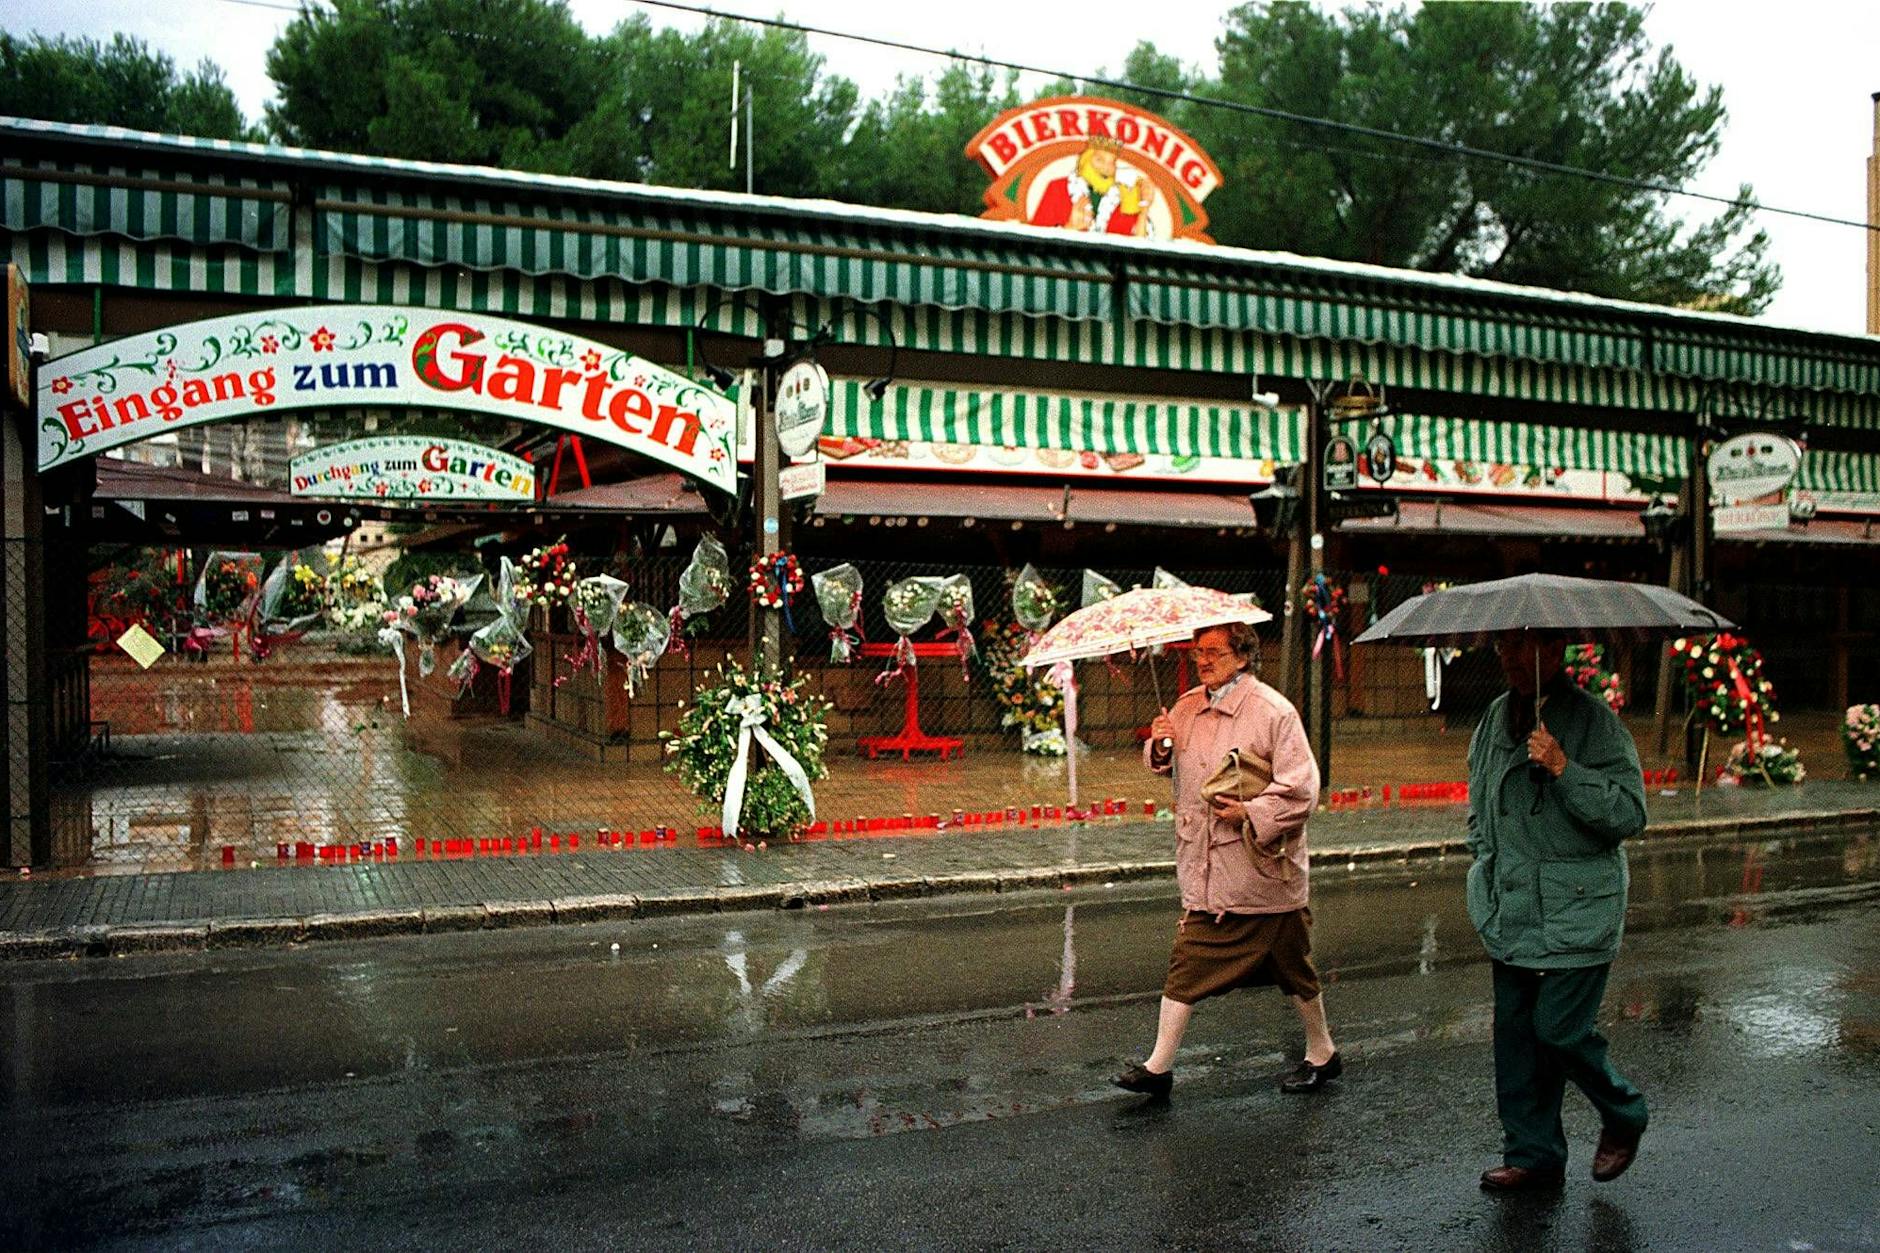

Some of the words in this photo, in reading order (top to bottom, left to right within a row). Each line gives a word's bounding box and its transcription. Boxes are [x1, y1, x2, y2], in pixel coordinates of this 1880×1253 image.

[57, 366, 276, 441] Eingang
[293, 361, 398, 391] zum
[411, 322, 702, 457] Garten
[293, 458, 379, 492] Durchgang
[384, 457, 418, 472] zum
[421, 445, 532, 496] Garten
